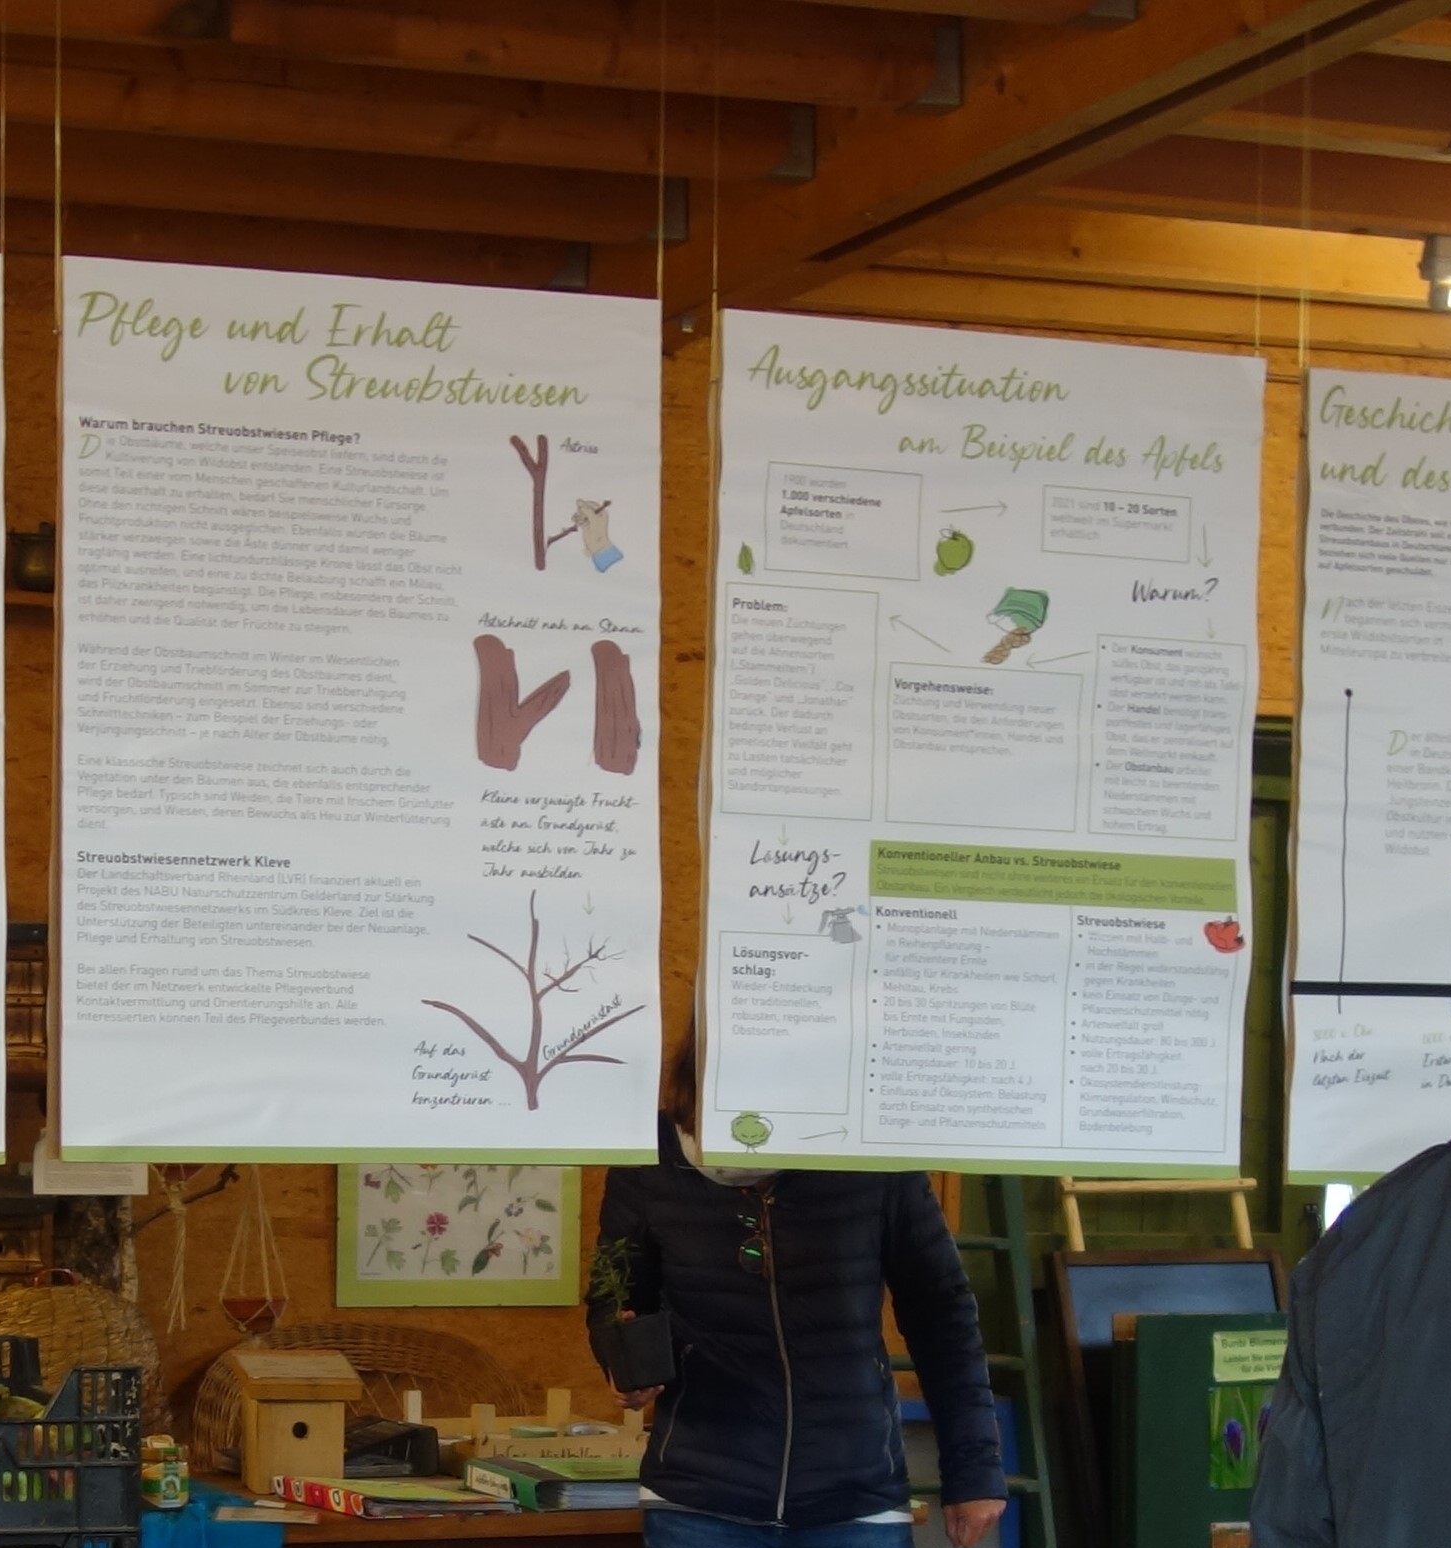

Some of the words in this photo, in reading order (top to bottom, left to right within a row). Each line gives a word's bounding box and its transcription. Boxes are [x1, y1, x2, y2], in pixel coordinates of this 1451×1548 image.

[77, 289, 206, 363] Pflege
[226, 307, 305, 345] und
[325, 302, 457, 353] Erhalt
[223, 371, 286, 396] von
[305, 352, 585, 408] Streuobstwiesen
[747, 343, 1069, 416] Ausgangssituation
[78, 416, 129, 430] Warum
[131, 418, 195, 434] brauchen
[197, 422, 308, 441] Streuobstwiesen
[311, 429, 361, 447] Pflege?
[898, 435, 940, 454] am
[961, 422, 1076, 473] Beispiel
[1084, 438, 1126, 468] des
[1141, 434, 1225, 480] Apfels
[1319, 452, 1386, 486] und
[1400, 455, 1450, 492] des
[1131, 577, 1219, 603] Warum?
[732, 597, 787, 612] Problem:
[893, 677, 993, 696] Vorgehensweise:
[76, 850, 251, 867] Streuobstwiesennetzwerk
[254, 855, 291, 869] Kleve
[749, 839, 844, 876] Lösungs-
[877, 847, 972, 866] Konventioneller
[973, 852, 1011, 866] Anbau
[1013, 857, 1030, 867] vs.
[1031, 854, 1122, 871] Streuobstwiese
[748, 870, 847, 904] ansätze?
[875, 905, 958, 920] Konventionell
[1076, 914, 1166, 930] Streuobstwiese
[732, 946, 809, 962] Lösungsvor-
[731, 964, 776, 979] schlag:
[413, 1040, 437, 1059] Auf
[442, 1043, 466, 1057] das
[411, 1064, 491, 1088] Grundgerüst
